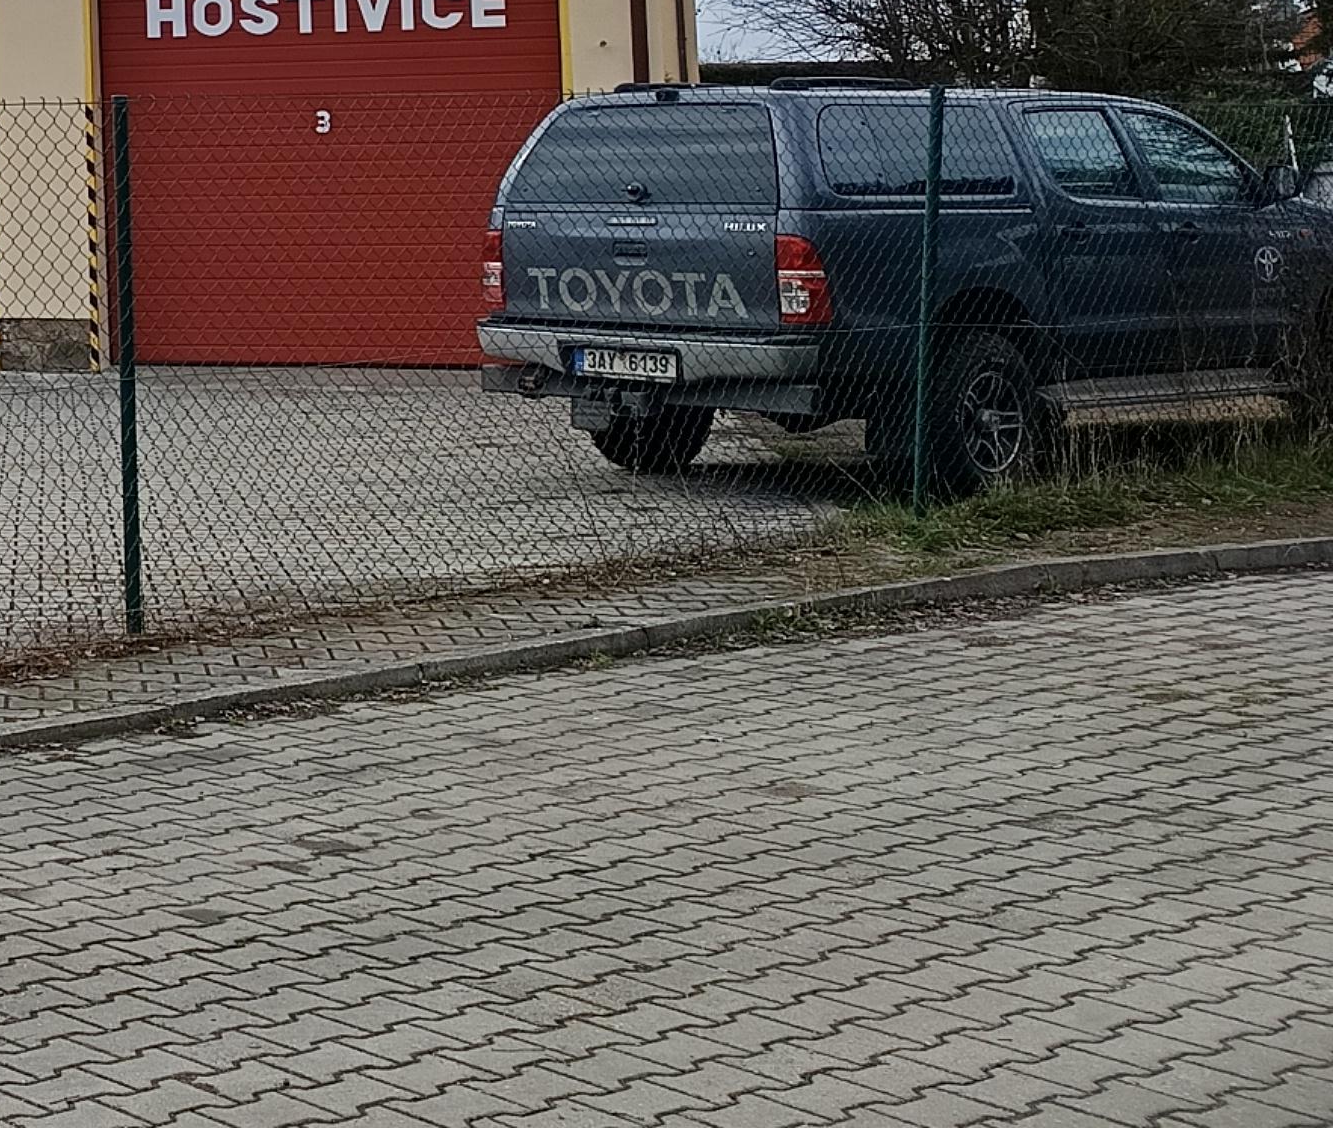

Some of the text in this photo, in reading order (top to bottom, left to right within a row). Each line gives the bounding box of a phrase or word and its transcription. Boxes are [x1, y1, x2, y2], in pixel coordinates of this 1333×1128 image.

[315, 110, 331, 133] 3
[723, 222, 767, 232] HILUX
[527, 267, 749, 319] TOYOTA
[587, 350, 670, 375] 3AY 6139
